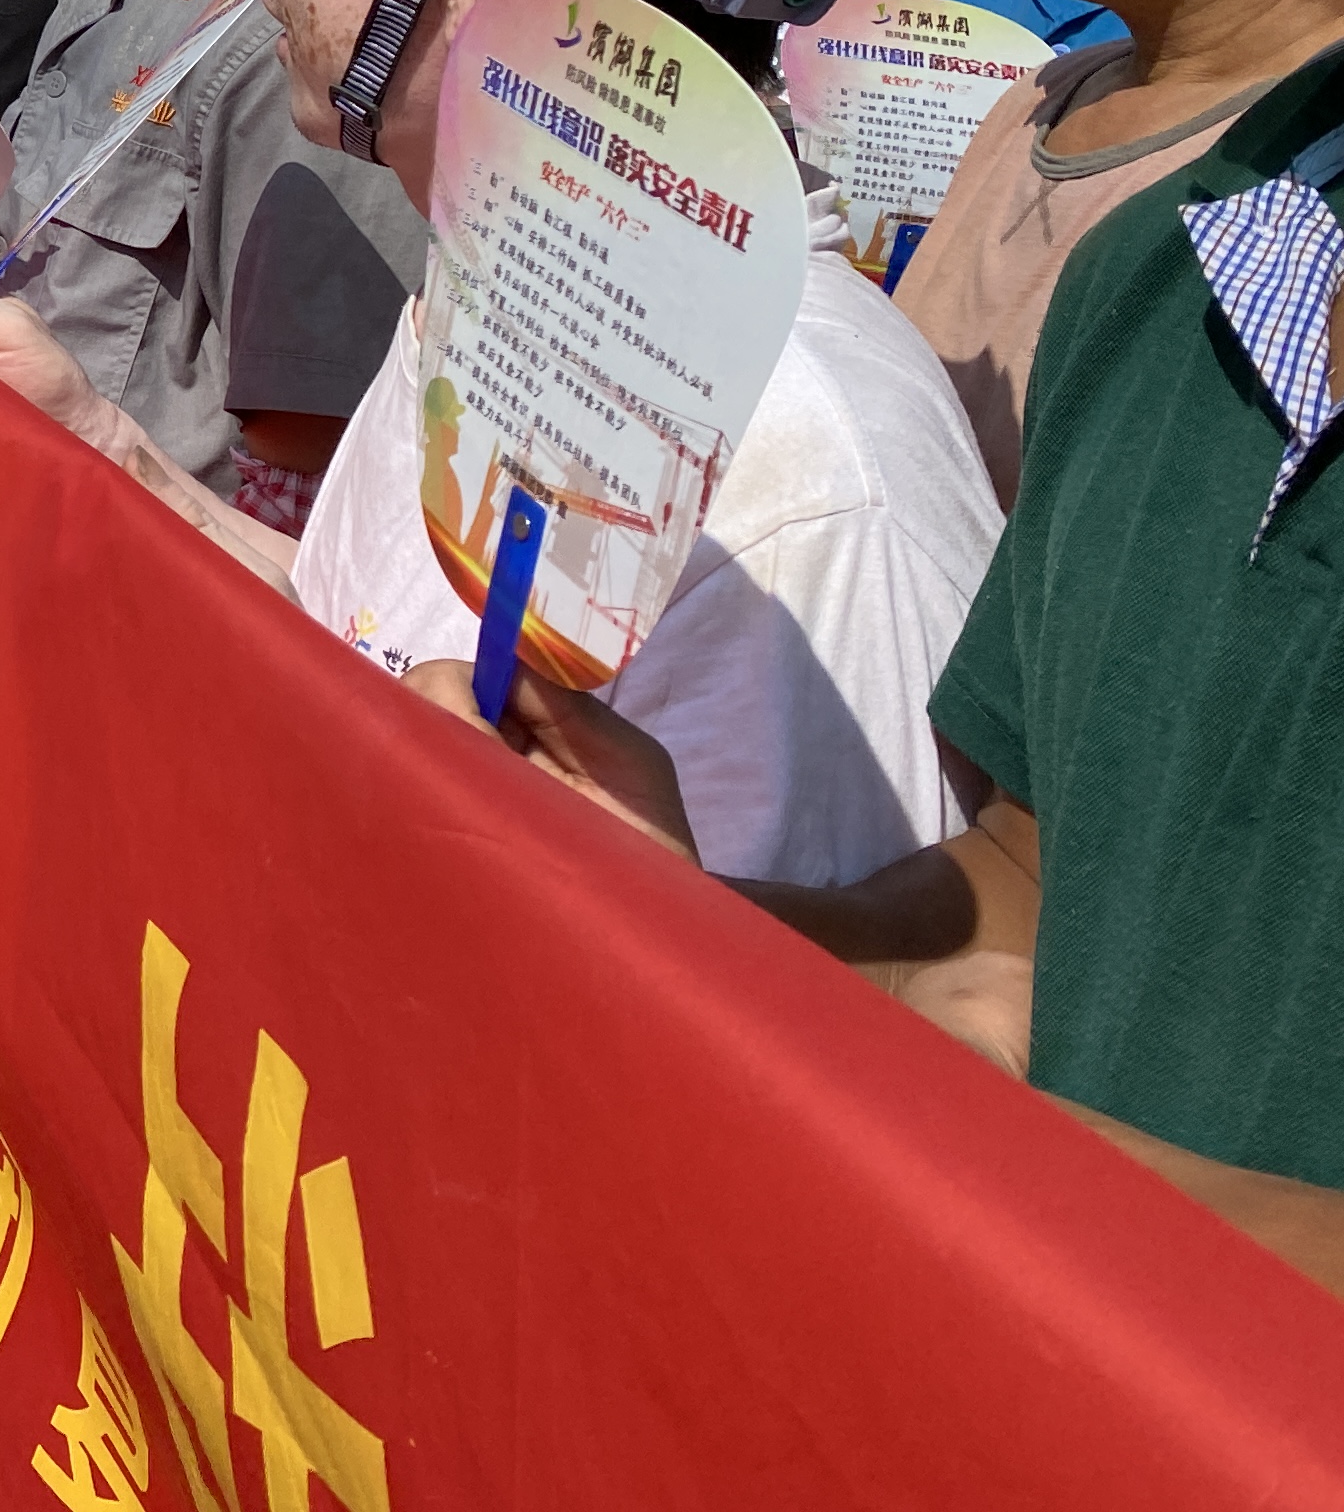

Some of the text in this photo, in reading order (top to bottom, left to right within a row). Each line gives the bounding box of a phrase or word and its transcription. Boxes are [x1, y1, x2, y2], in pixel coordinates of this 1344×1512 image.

[481, 56, 755, 254] 强化红线意识 落实安全责任
[539, 160, 591, 204] 安全生产
